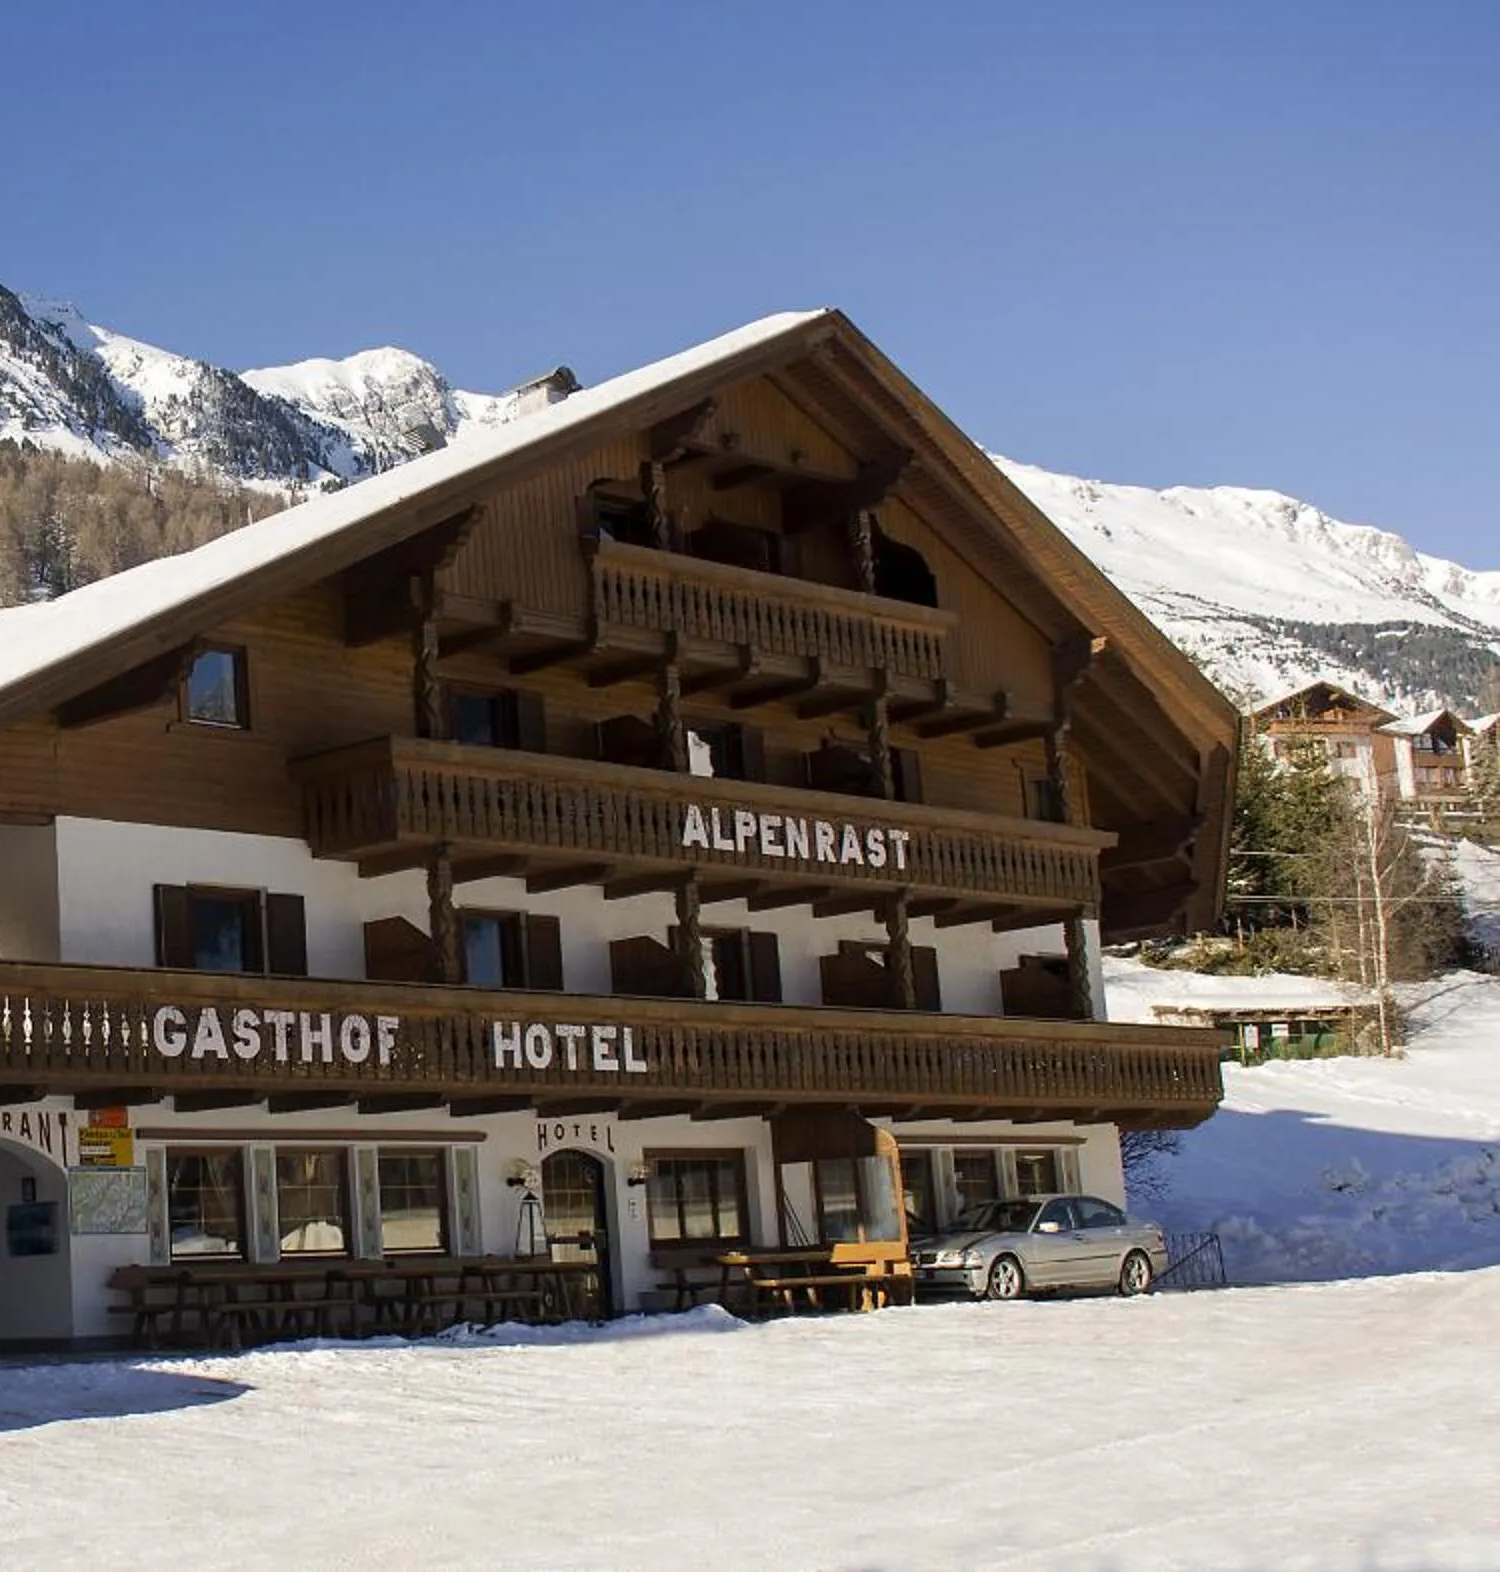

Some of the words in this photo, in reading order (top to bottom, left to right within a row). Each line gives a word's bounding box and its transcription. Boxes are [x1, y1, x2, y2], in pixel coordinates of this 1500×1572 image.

[682, 804, 909, 870] ALPENRAST
[153, 1005, 399, 1065] GASTHOF
[493, 1020, 647, 1073] HOTEL
[537, 1123, 615, 1153] HOTEL
